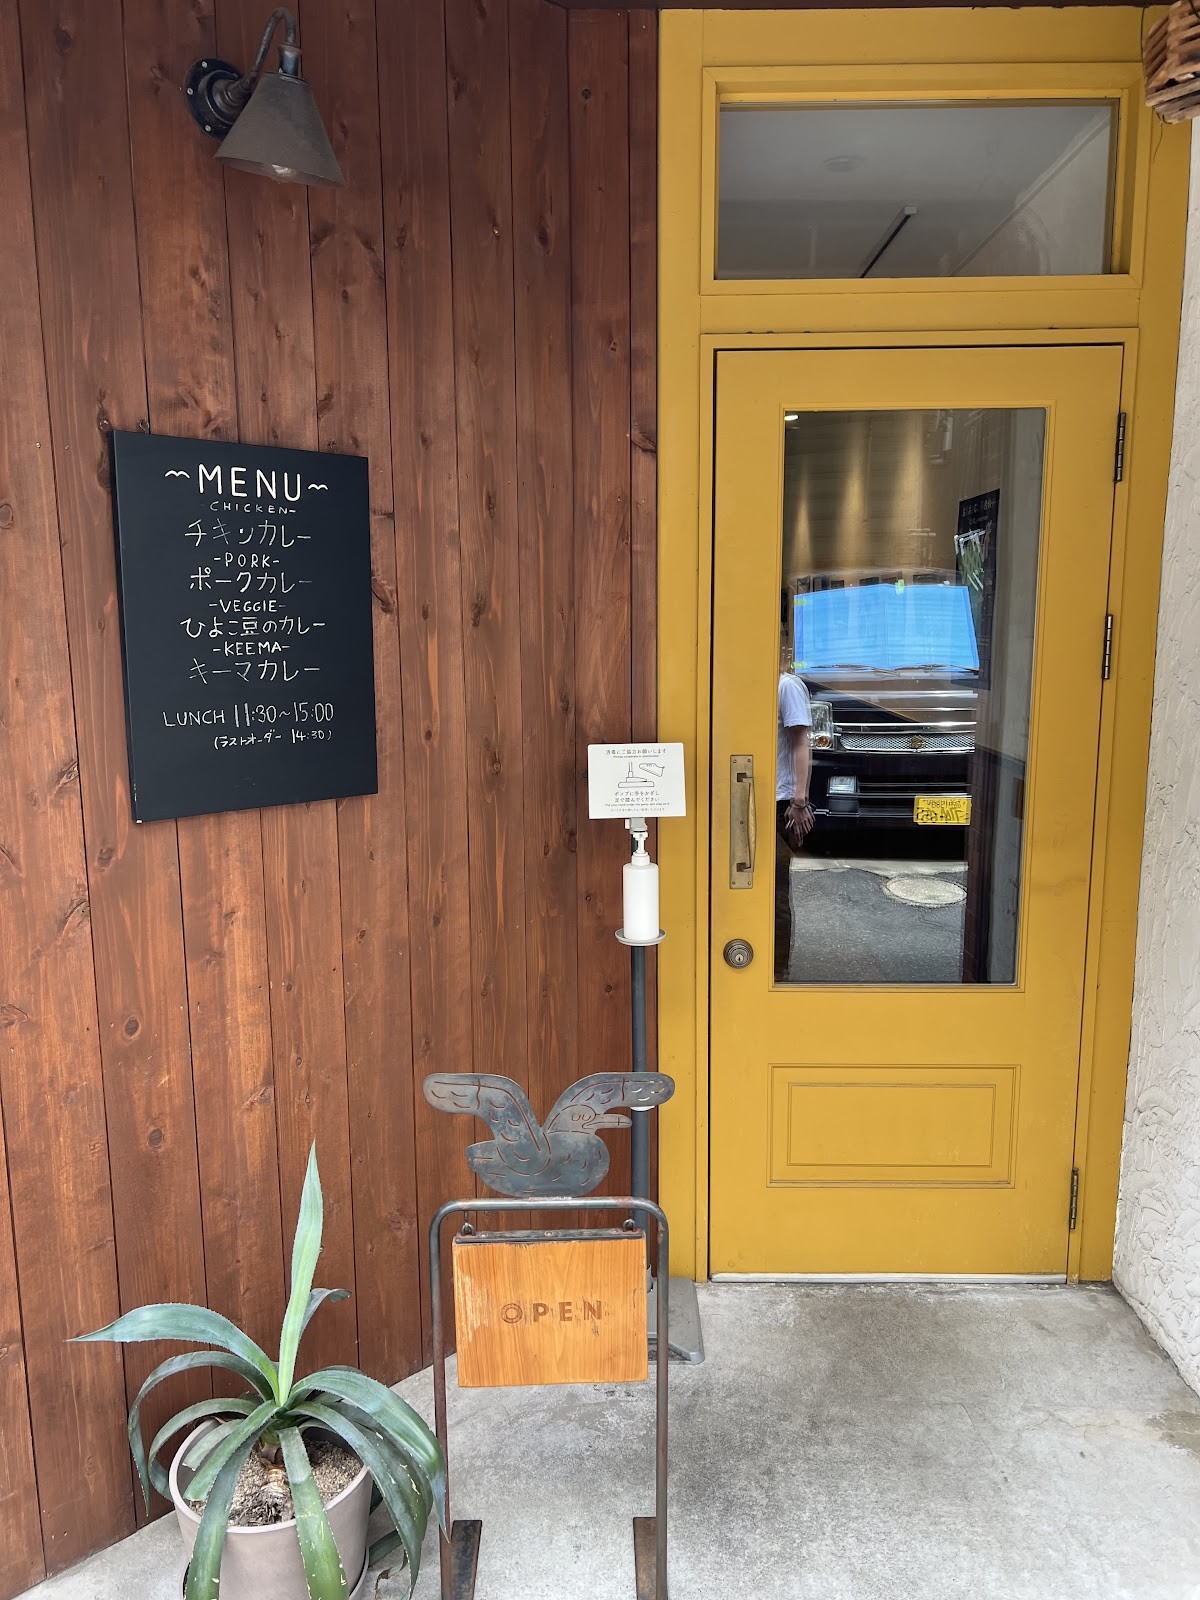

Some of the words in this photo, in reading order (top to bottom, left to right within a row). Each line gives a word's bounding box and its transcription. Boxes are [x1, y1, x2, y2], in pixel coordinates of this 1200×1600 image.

[198, 463, 301, 502] MENU
[184, 517, 312, 548] チキンカレー
[189, 566, 313, 594] ポークカレー
[179, 615, 326, 639] ひよこ豆のカレー
[188, 657, 321, 685] キーマカレー
[162, 708, 226, 727] LUNCH
[500, 1299, 603, 1324] OPEN
